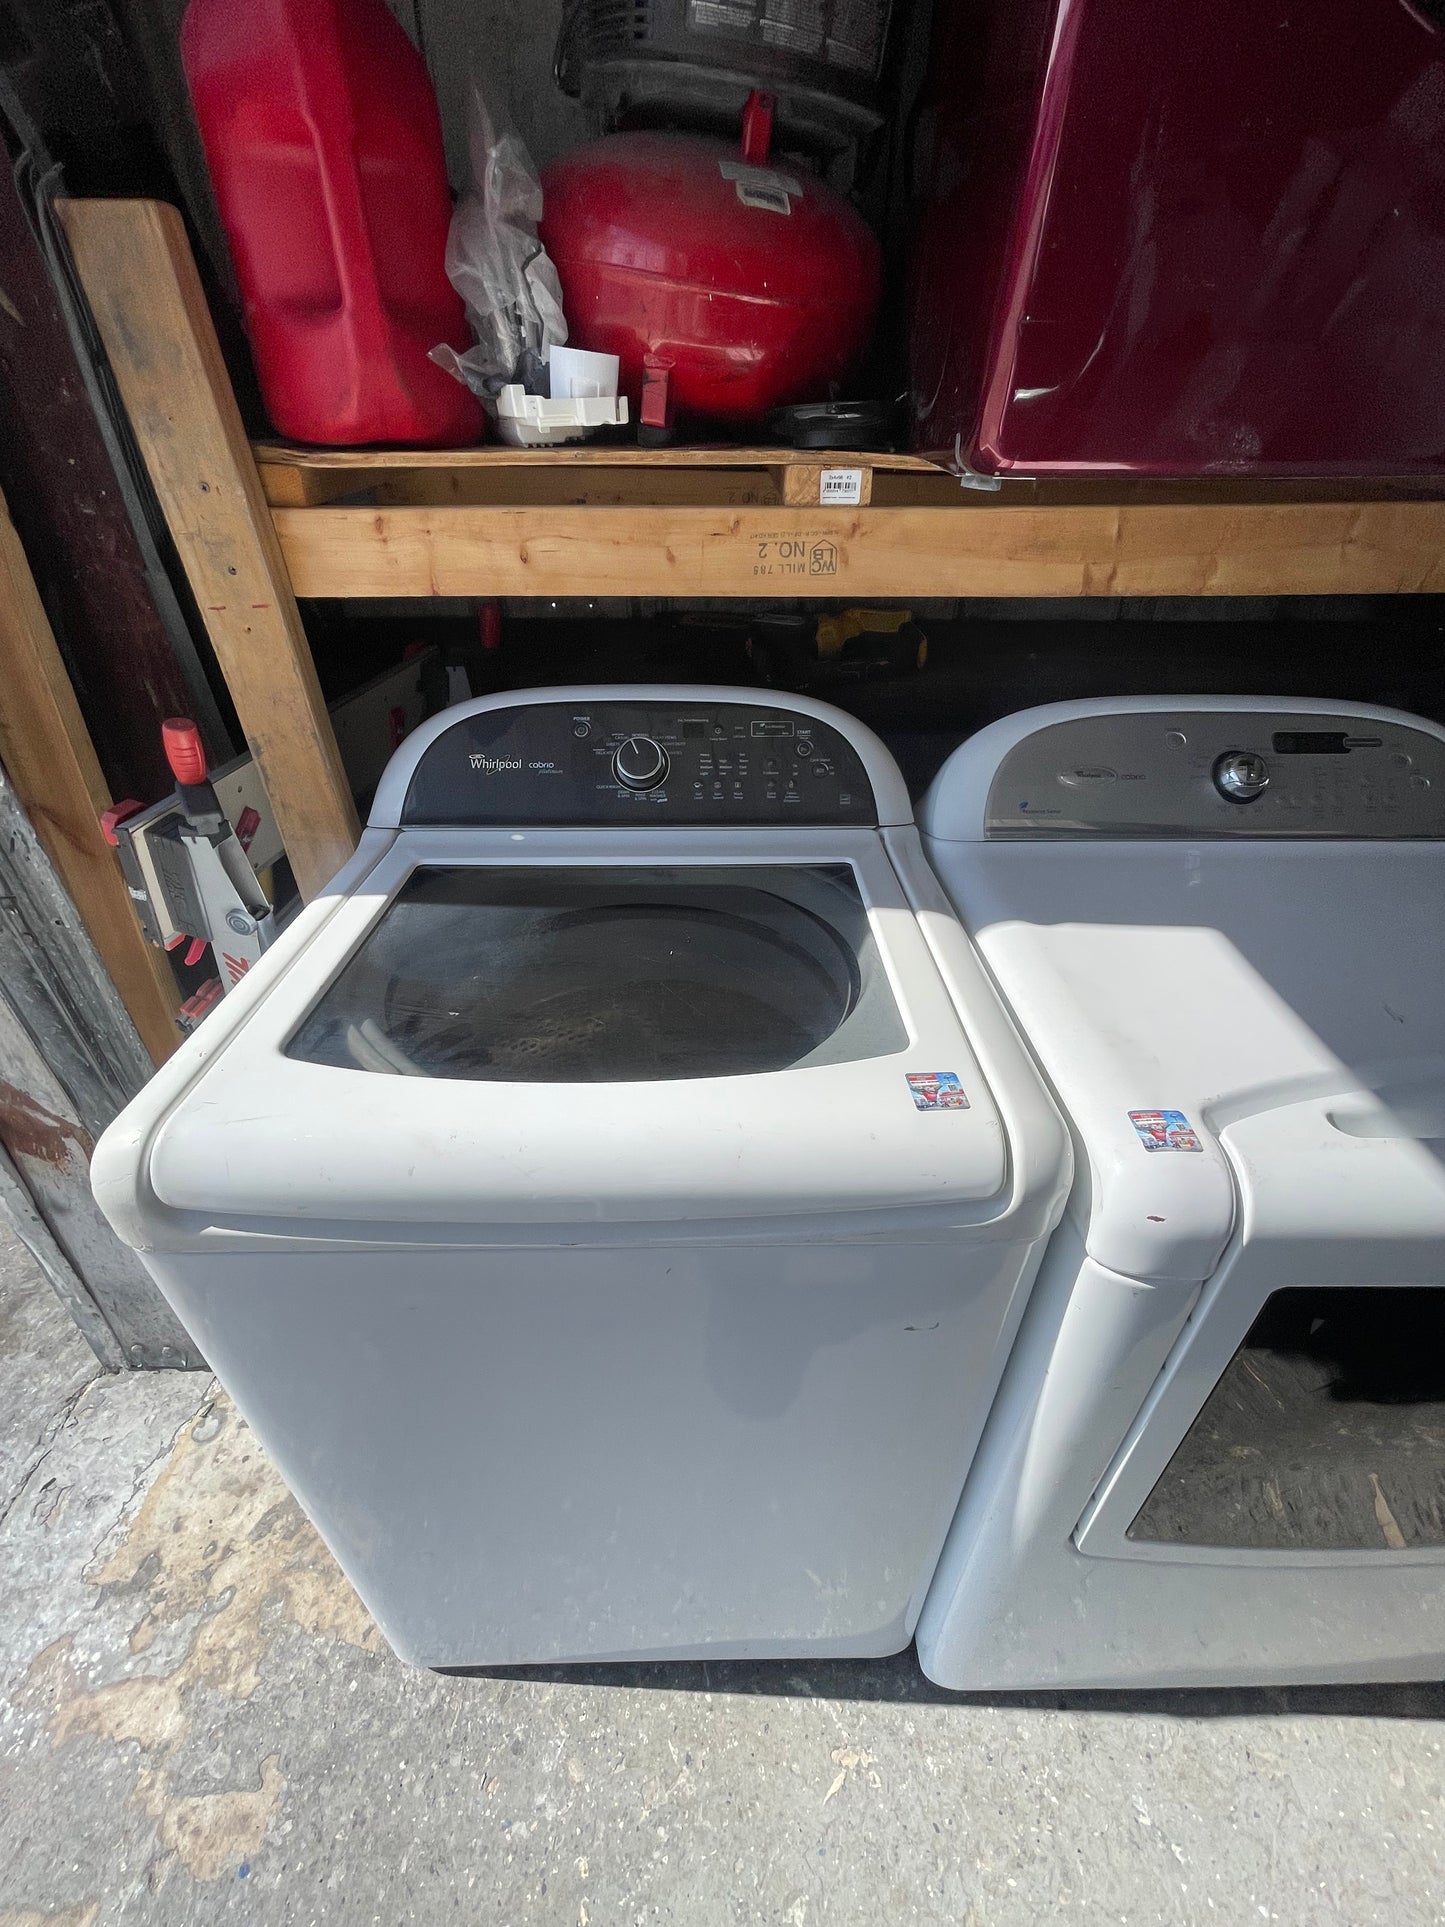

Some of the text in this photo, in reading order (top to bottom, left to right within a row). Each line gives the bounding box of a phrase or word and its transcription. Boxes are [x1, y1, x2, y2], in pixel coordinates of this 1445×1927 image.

[758, 541, 806, 559] NO. 2
[780, 563, 806, 574] MILL
[470, 758, 554, 772] Whirlpool cabrio
